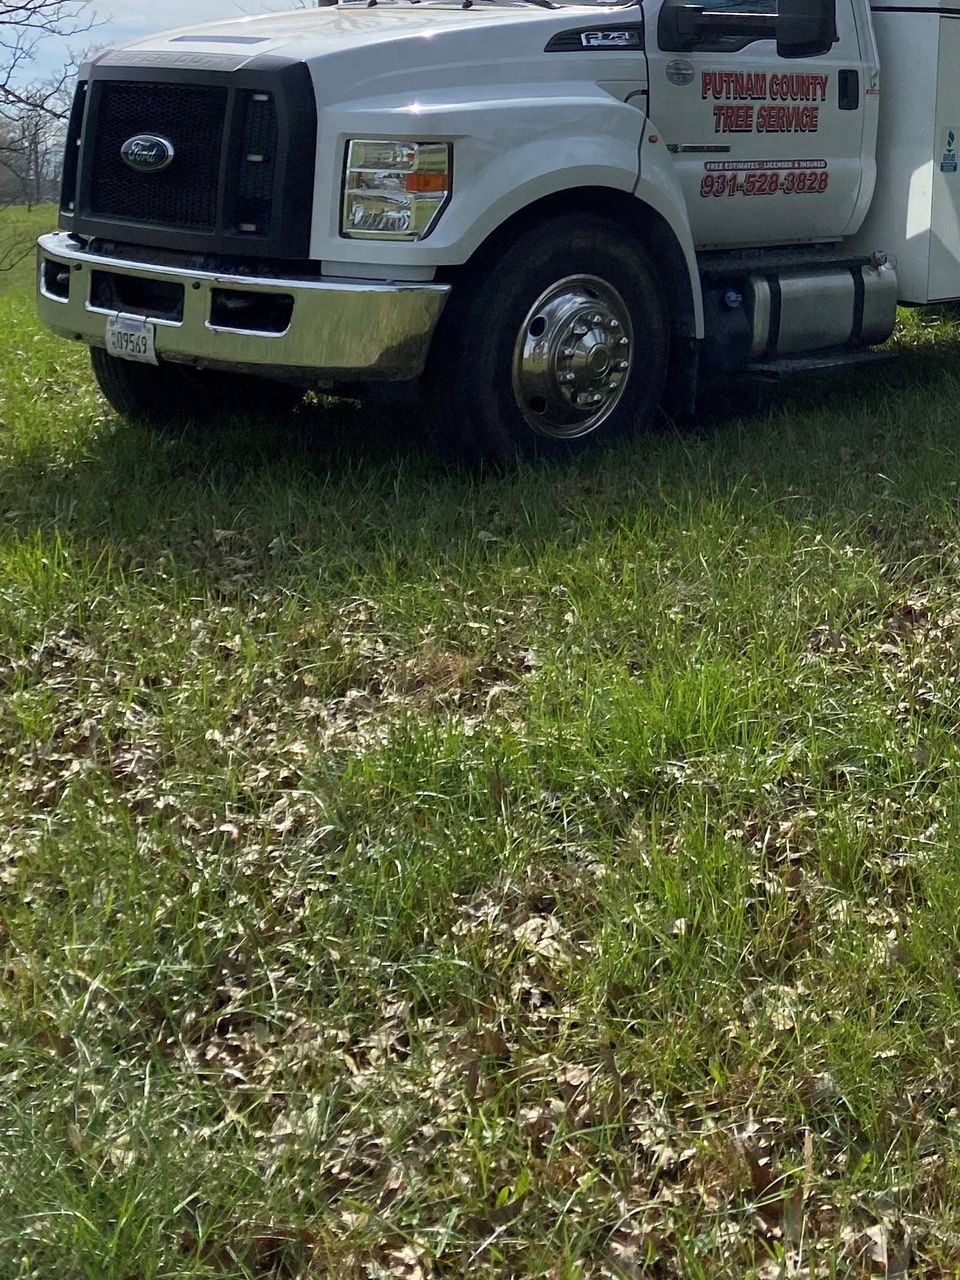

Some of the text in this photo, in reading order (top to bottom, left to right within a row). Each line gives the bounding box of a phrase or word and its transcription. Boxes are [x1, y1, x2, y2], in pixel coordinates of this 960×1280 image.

[702, 71, 766, 100] PUTNAM
[769, 73, 829, 101] COUNTY
[713, 105, 819, 133] TREE SERVICE
[128, 140, 157, 162] Ford
[706, 162, 723, 170] FREE
[724, 162, 759, 170] ESTIMATES
[764, 161, 793, 169] LICENSED
[800, 160, 826, 169] INSURED
[701, 172, 829, 198] 931-528-3828
[117, 331, 147, 354] 09569
